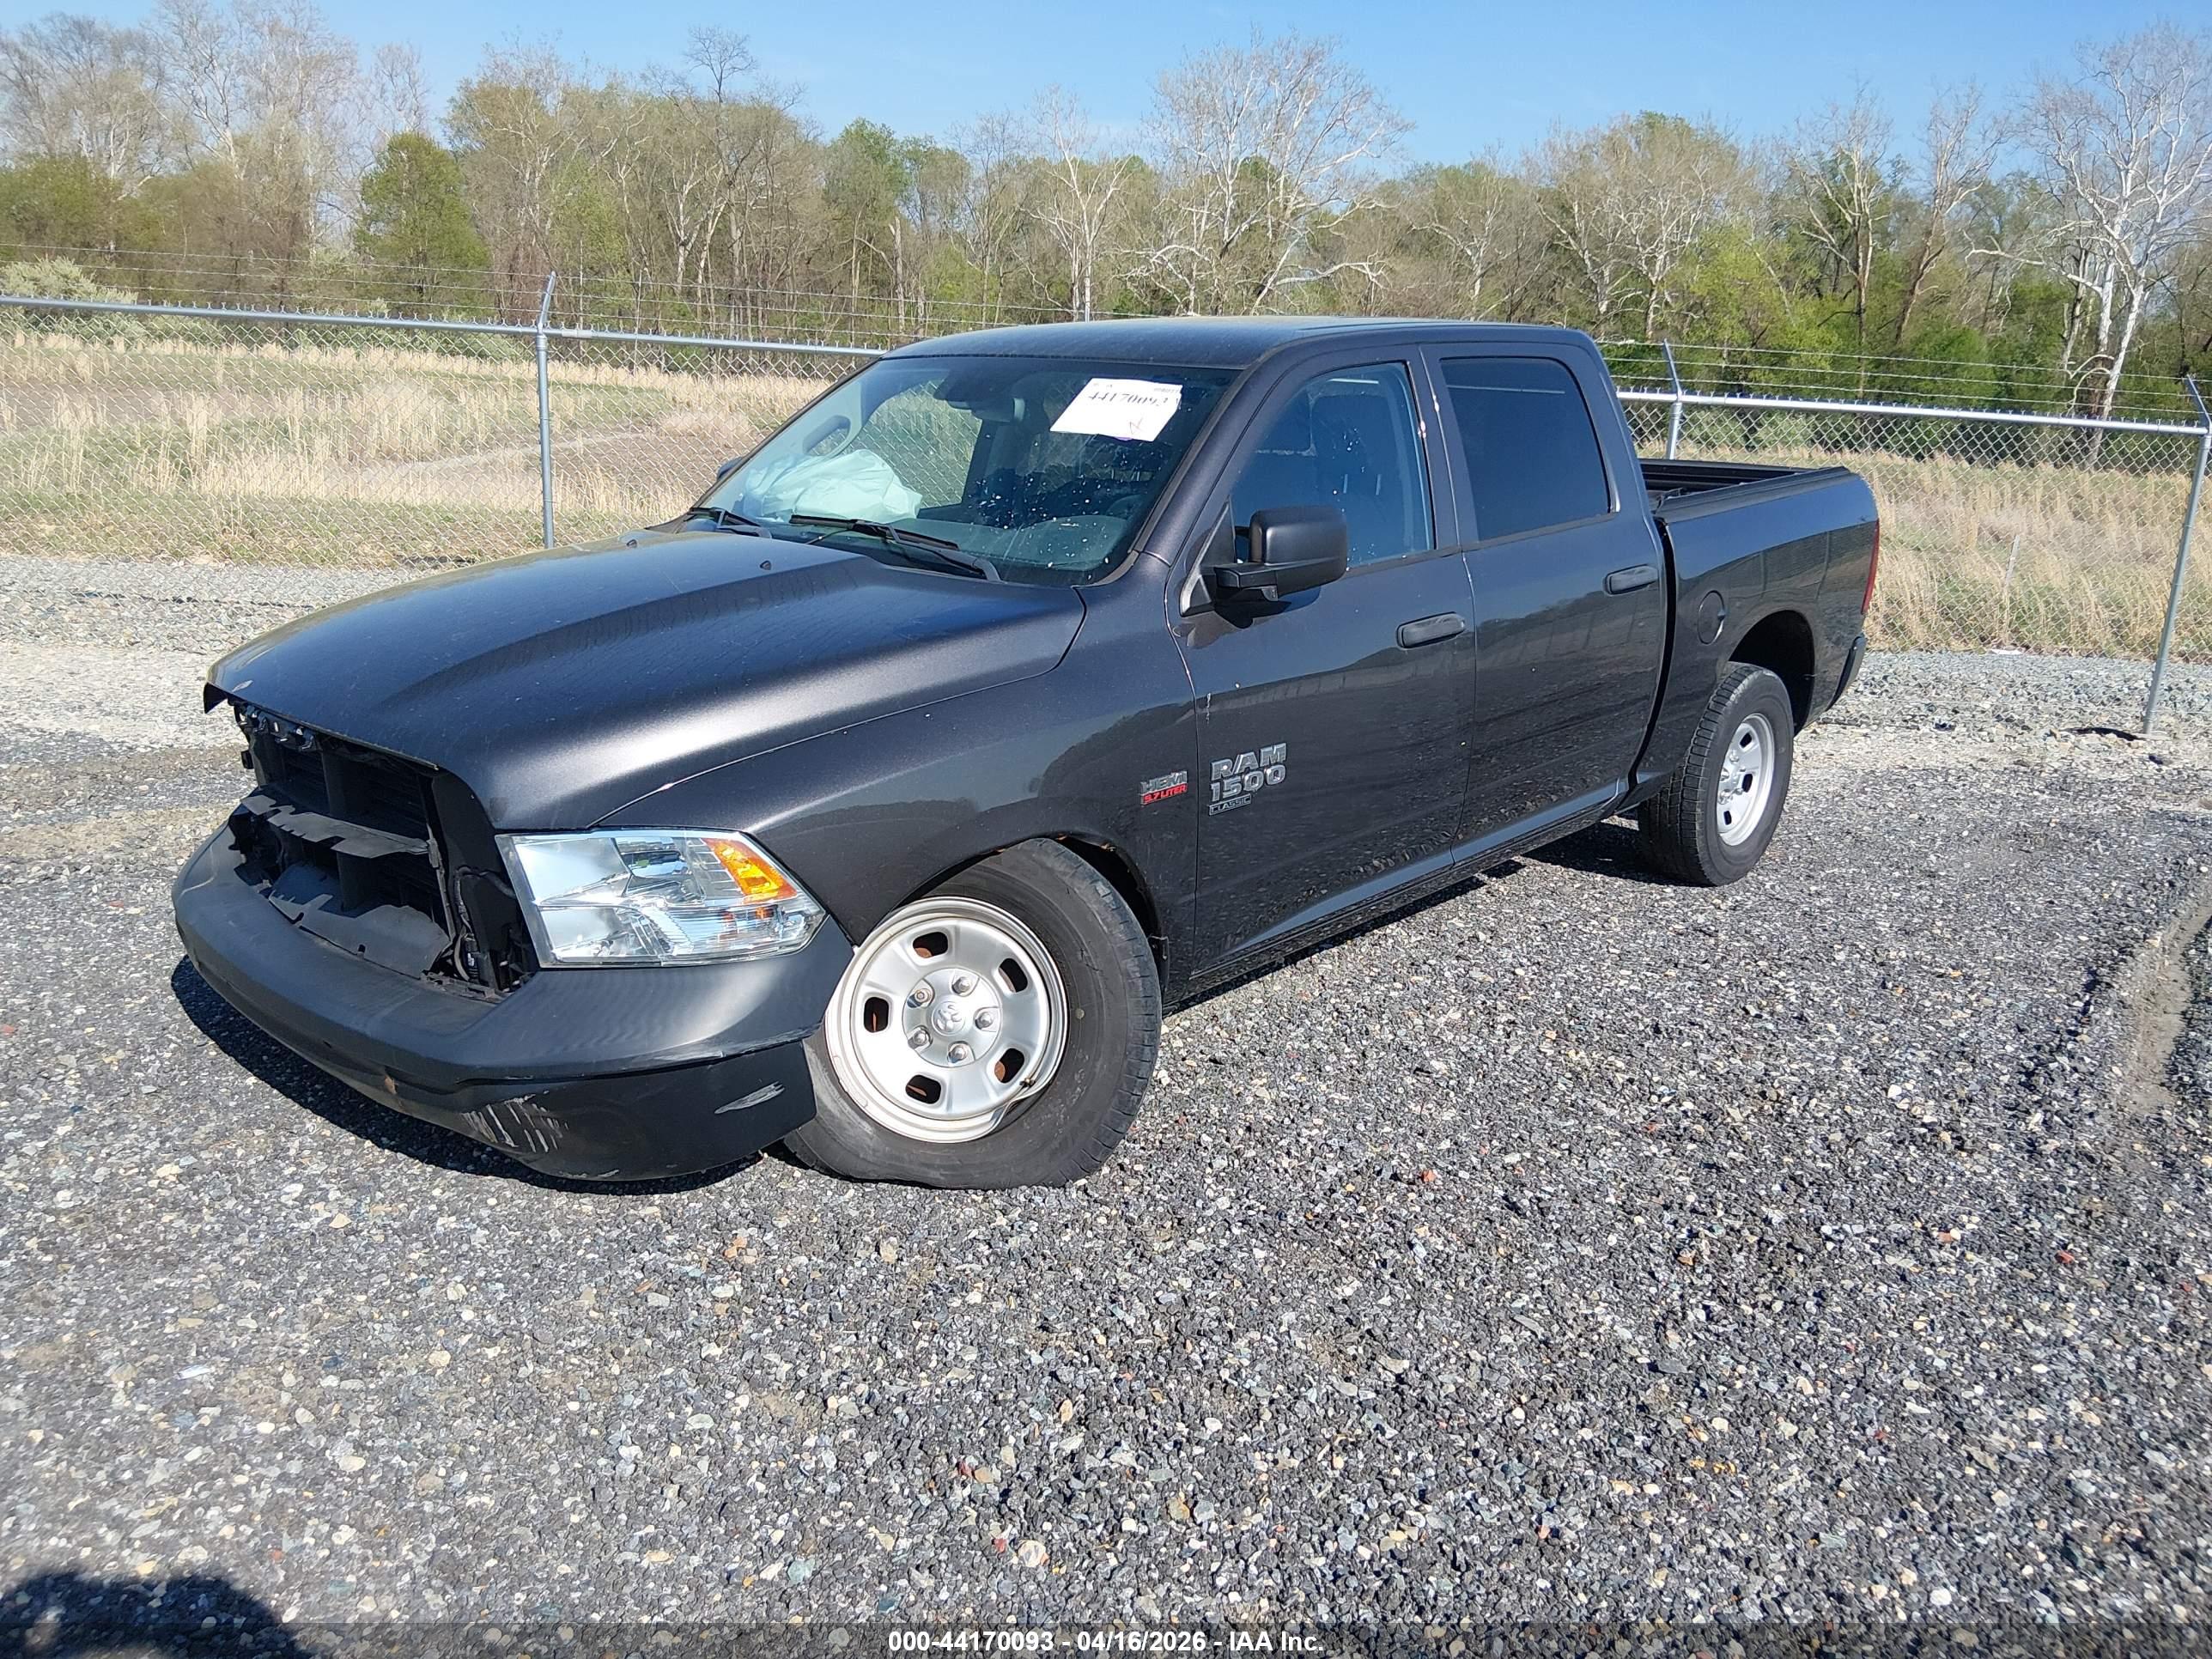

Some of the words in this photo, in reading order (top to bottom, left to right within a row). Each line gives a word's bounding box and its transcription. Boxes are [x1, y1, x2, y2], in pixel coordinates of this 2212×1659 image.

[1210, 743, 1287, 781] RAM
[1140, 770, 1188, 794] HEMI
[1210, 764, 1286, 802] 1500
[1210, 795, 1251, 814] CLASSIC
